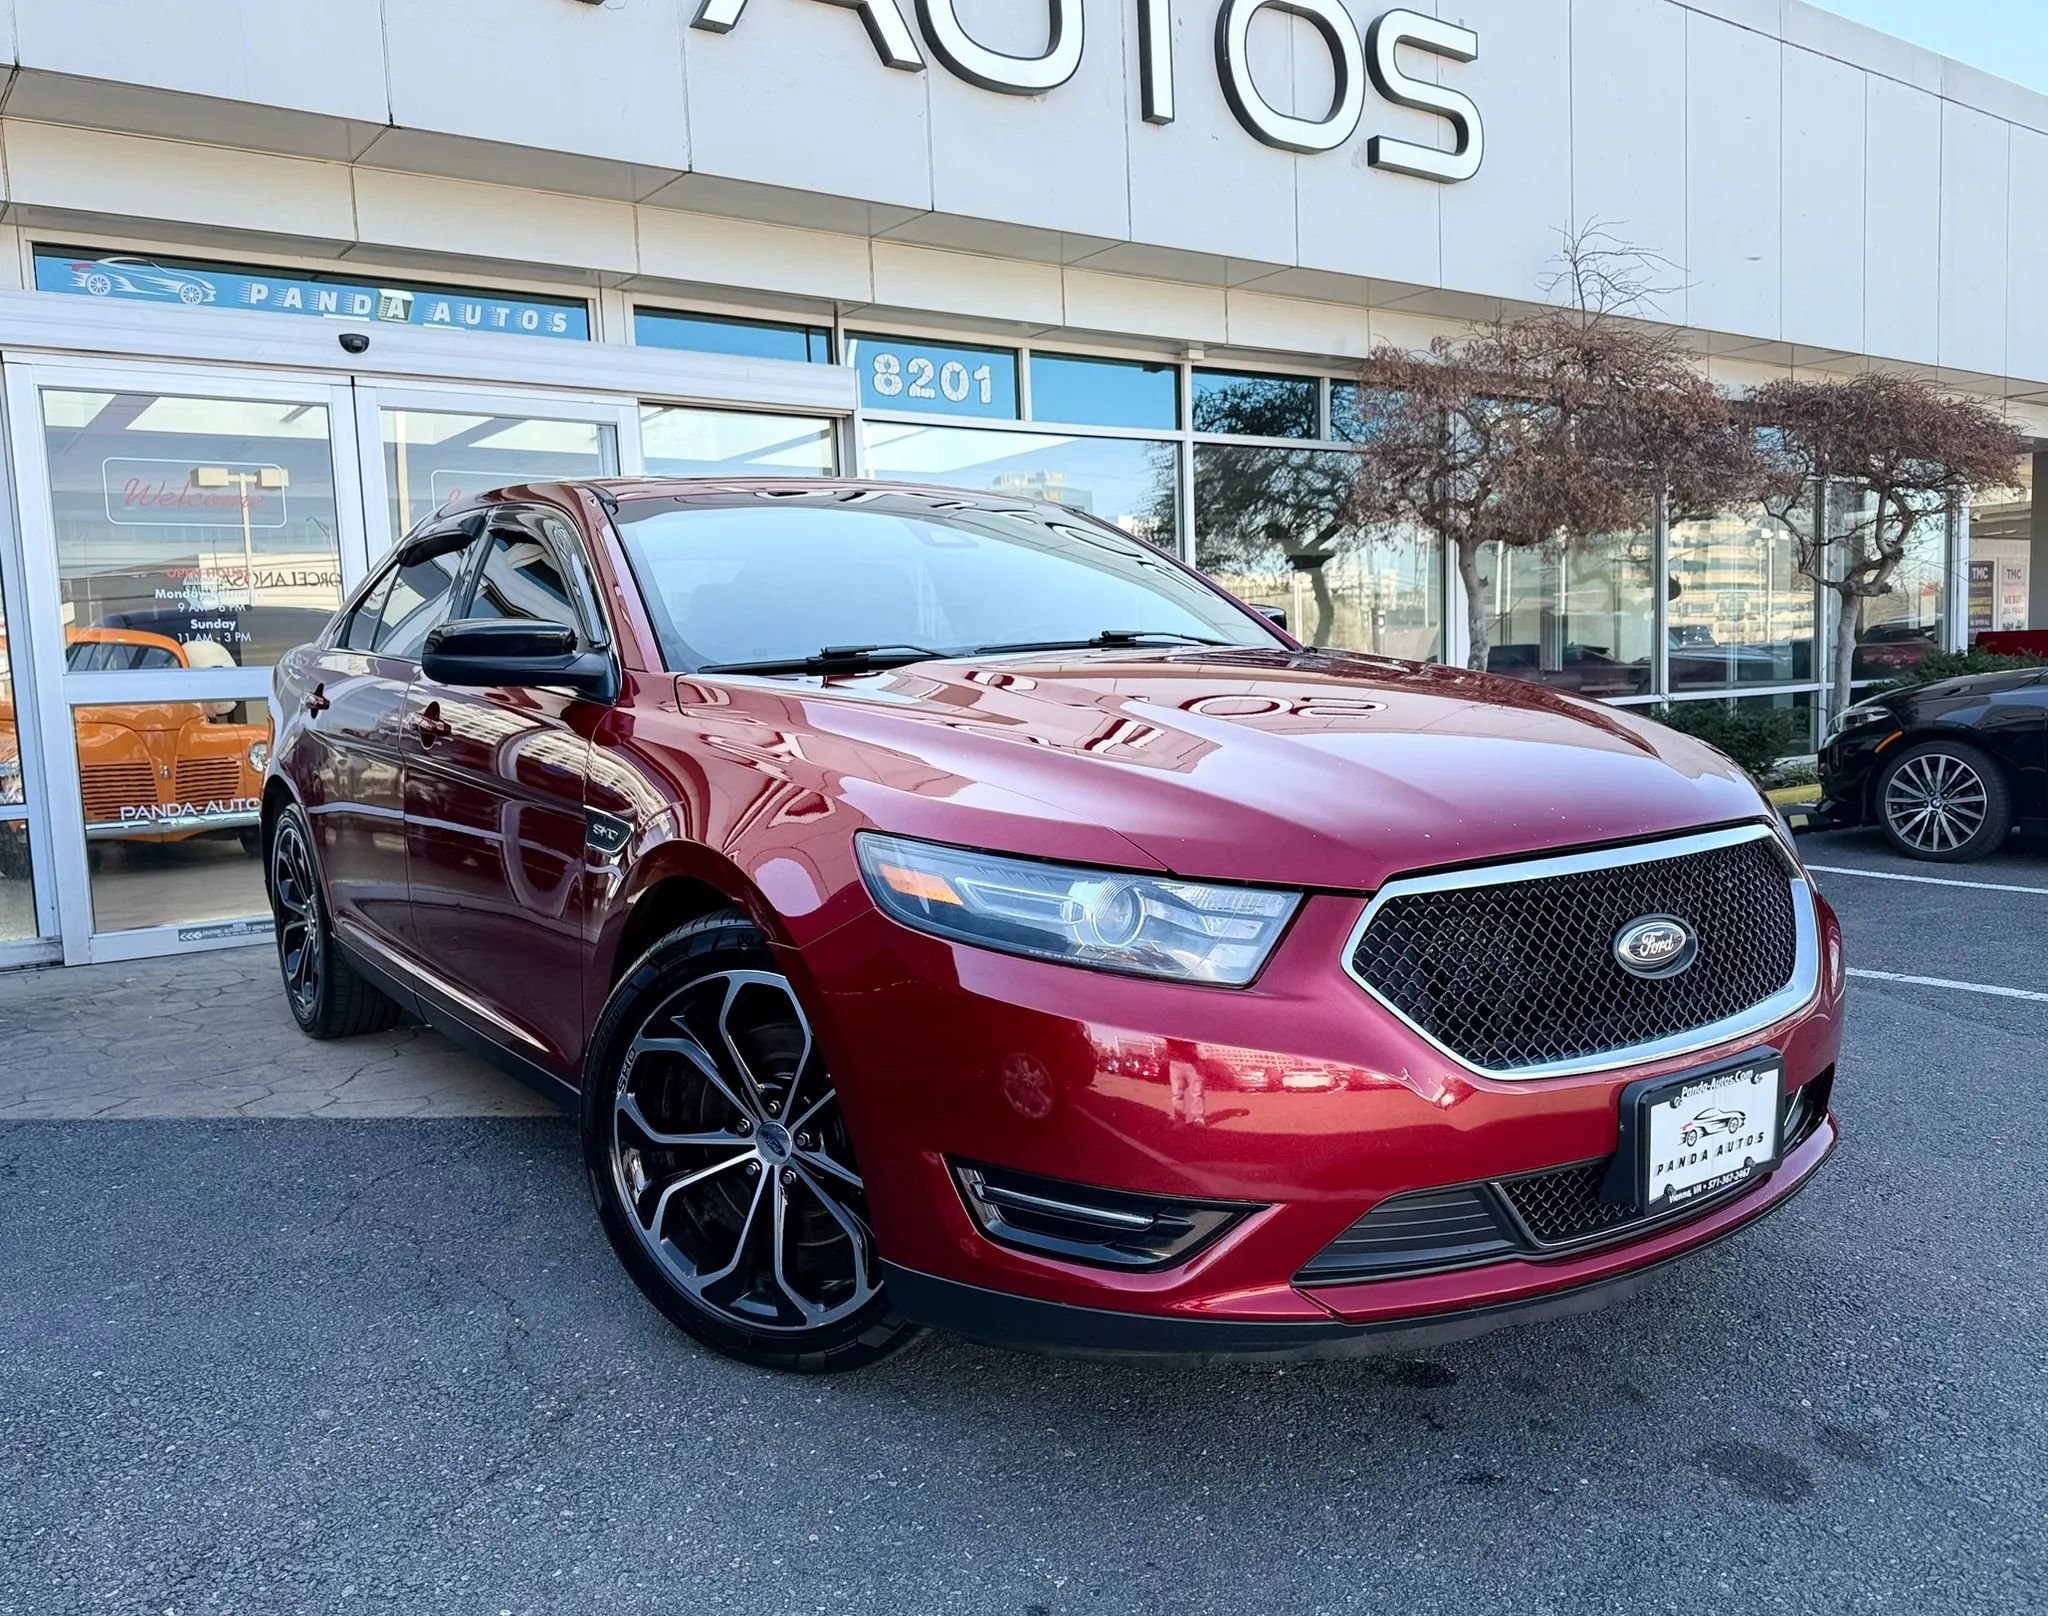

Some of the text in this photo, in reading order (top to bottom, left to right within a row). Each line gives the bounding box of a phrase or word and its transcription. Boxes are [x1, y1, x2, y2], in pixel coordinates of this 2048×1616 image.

[249, 283, 568, 333] PANDA AUTOS
[873, 352, 991, 404] 8201
[124, 478, 265, 508] Welcome
[1972, 567, 1988, 579] TMC
[2006, 569, 2022, 580] TMC
[155, 588, 205, 600] Monday
[178, 603, 185, 612] 9
[219, 603, 226, 612] 6
[230, 603, 246, 612] PM
[178, 633, 190, 643] 11
[195, 632, 213, 642] AM
[224, 632, 231, 642] 3
[235, 632, 252, 642] PM
[190, 618, 236, 631] Sunday
[1640, 931, 1674, 957] Ford
[617, 1047, 636, 1094] SHO
[1681, 1069, 1753, 1098] Panda-Autos.Com
[1656, 1131, 1764, 1176] PANDA AUTOS
